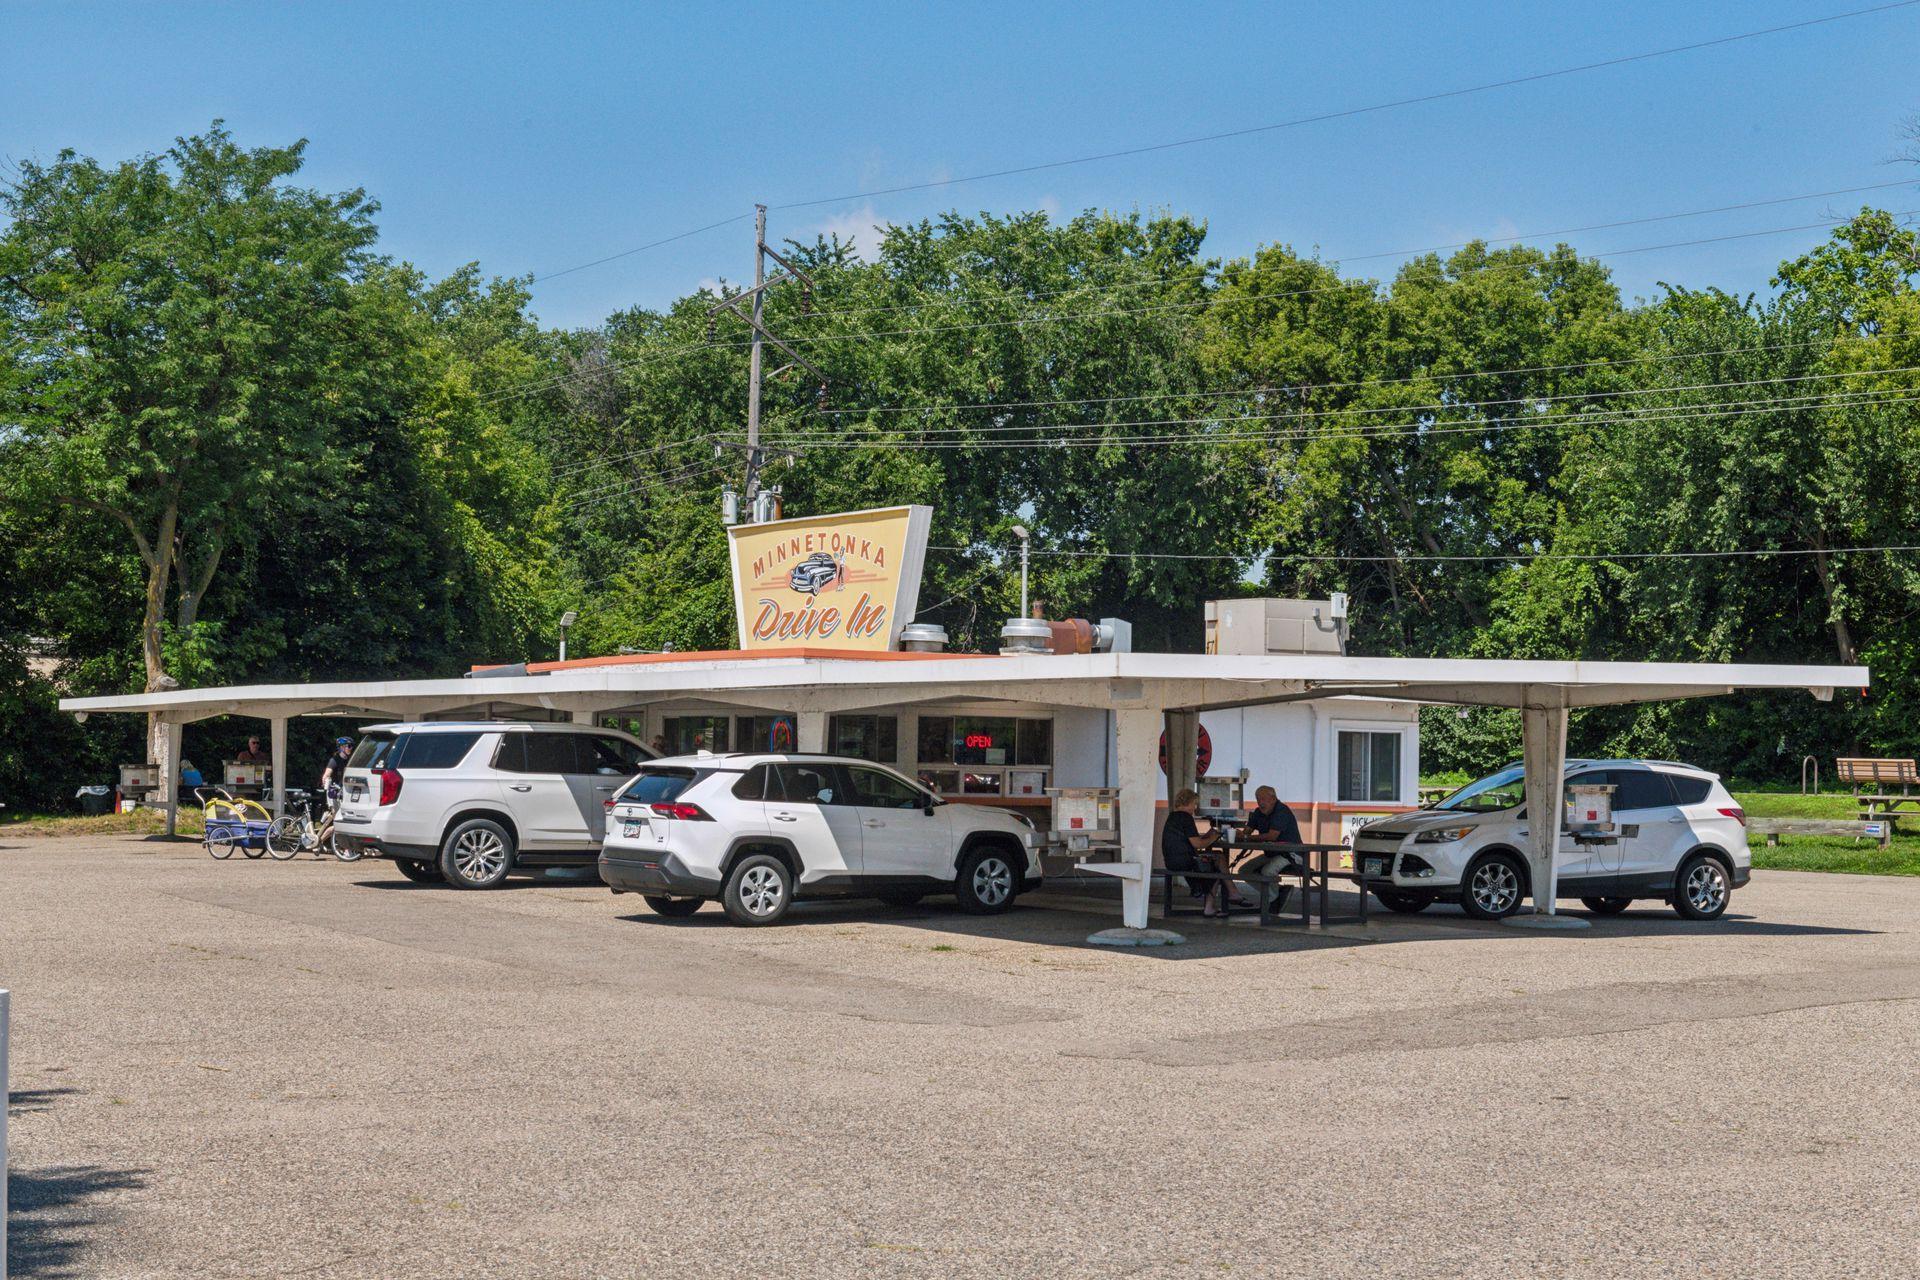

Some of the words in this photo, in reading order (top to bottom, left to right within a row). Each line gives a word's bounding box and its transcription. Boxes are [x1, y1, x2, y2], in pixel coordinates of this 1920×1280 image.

[753, 533, 885, 579] MINNETONKA
[752, 595, 841, 641] Drive
[846, 592, 886, 638] In
[966, 735, 992, 748] OPEN
